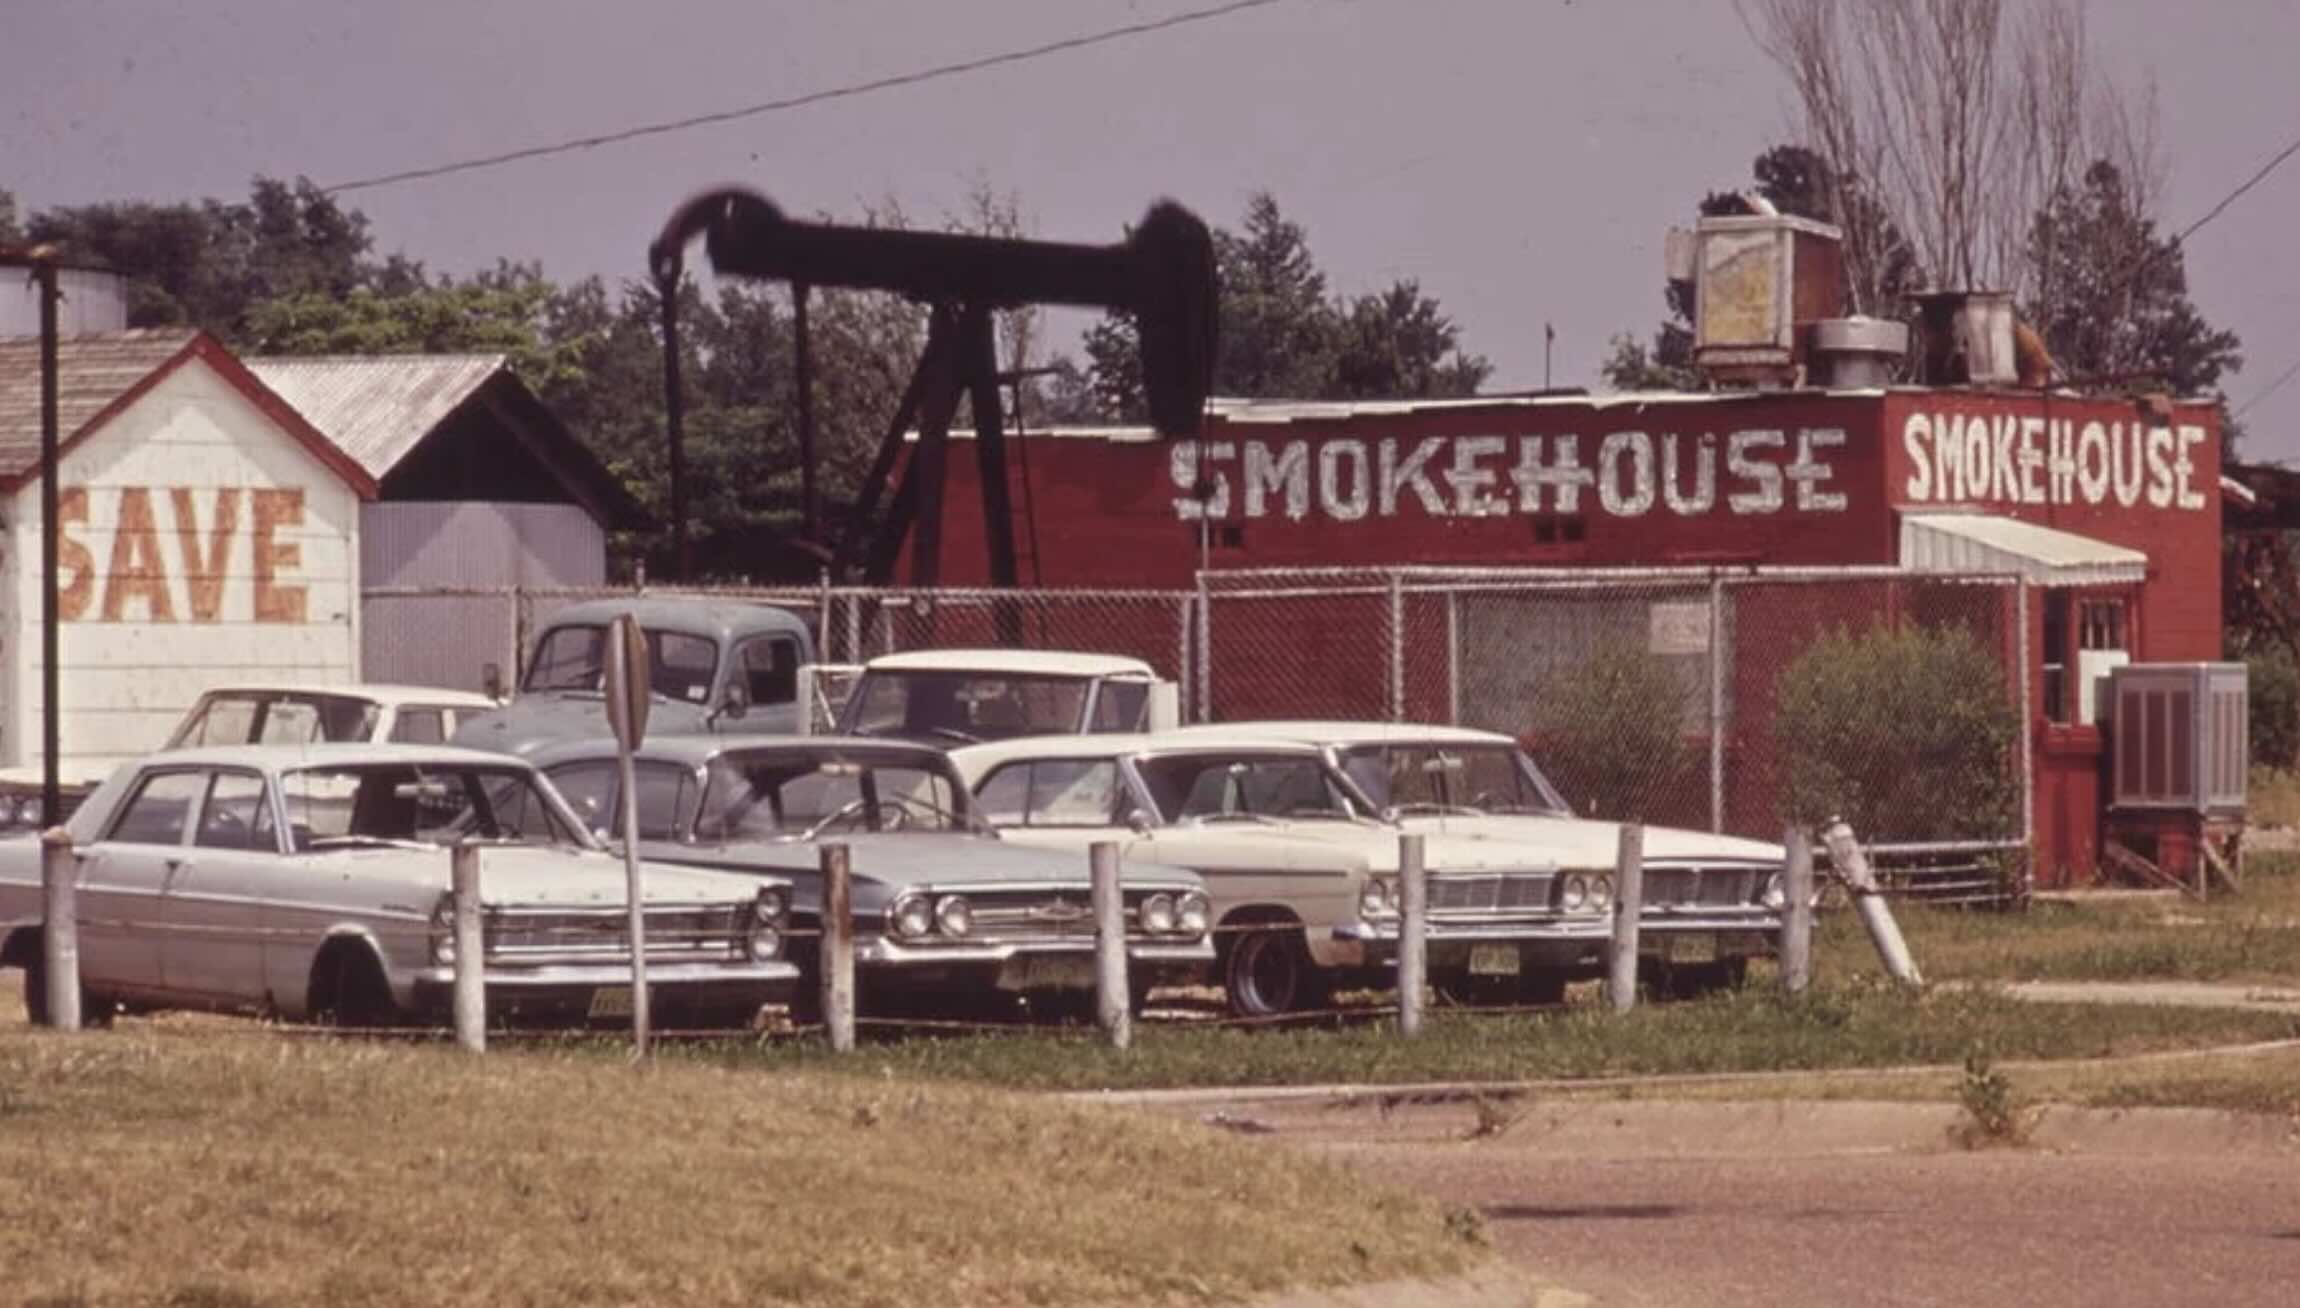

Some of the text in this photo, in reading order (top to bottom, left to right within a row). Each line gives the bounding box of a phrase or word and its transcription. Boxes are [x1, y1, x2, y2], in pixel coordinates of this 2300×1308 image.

[1170, 429, 1848, 521] SMOKEHOUSE
[1904, 413, 2205, 509] SMOKEHOUSE
[57, 486, 308, 624] SAVE
